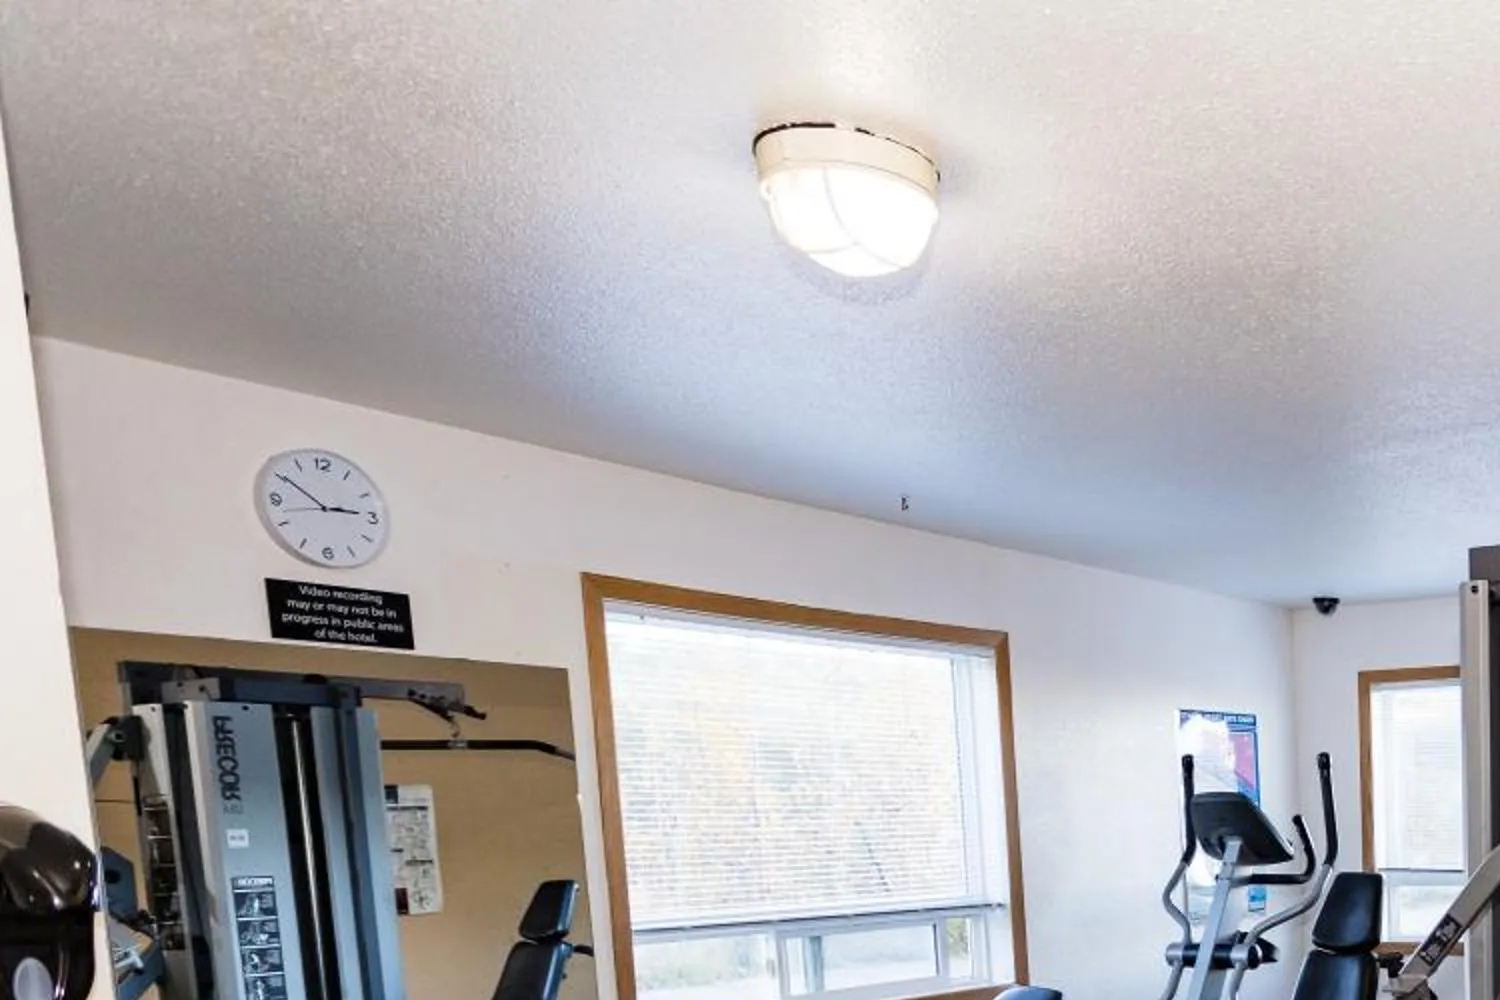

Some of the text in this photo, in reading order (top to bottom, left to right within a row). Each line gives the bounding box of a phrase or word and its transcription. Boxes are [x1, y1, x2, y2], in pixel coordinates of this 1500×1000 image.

[314, 458, 332, 472] 12
[269, 492, 283, 506] 9
[367, 511, 379, 525] 3
[321, 547, 335, 560] 6
[300, 586, 382, 605] Video recording
[287, 599, 397, 619] may or may not be in
[281, 612, 404, 633] progress in public areas
[314, 629, 379, 643] of the hotel.
